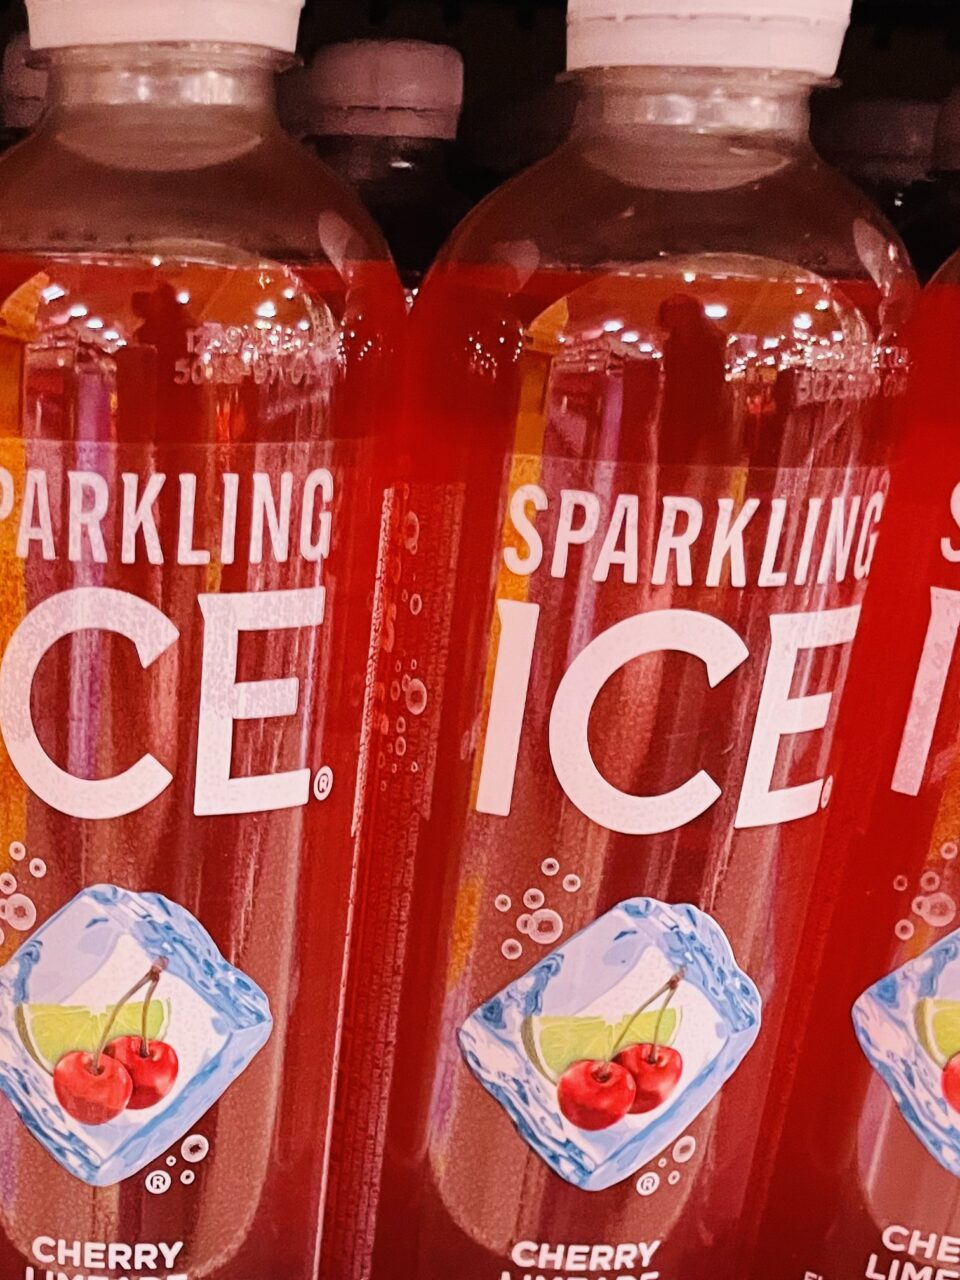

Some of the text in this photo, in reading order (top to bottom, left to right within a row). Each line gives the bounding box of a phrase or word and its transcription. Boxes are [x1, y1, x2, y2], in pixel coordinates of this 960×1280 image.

[503, 484, 883, 587] SPARKLING
[32, 1236, 183, 1270] CHERRY
[511, 1240, 662, 1271] CHERRY
[882, 1225, 960, 1263] CHE
